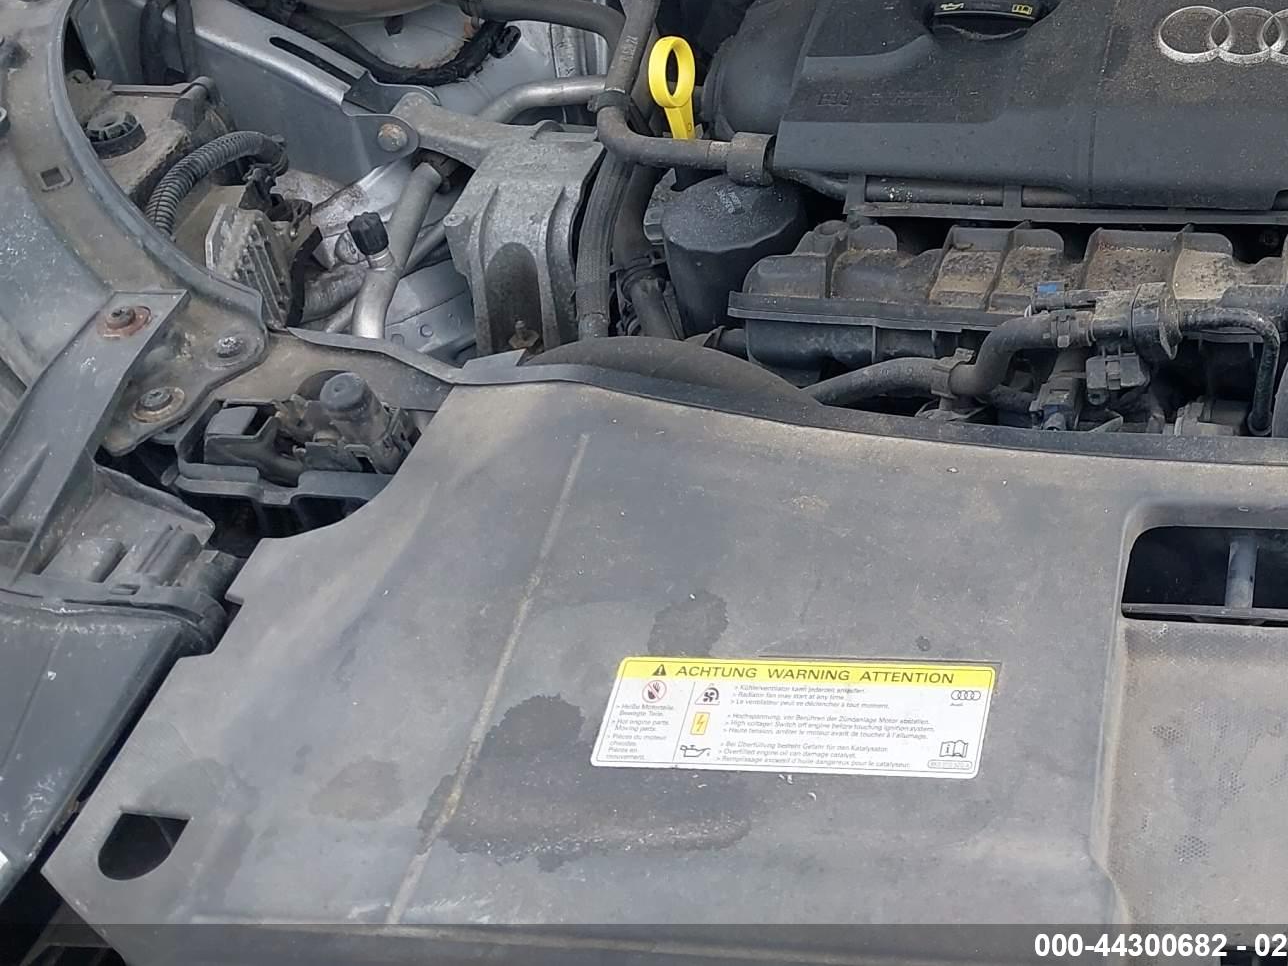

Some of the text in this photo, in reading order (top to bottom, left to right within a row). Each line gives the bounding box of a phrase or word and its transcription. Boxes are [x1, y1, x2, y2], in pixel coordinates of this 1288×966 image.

[675, 666, 954, 684] ACHTUNG WARNING ATTENTION
